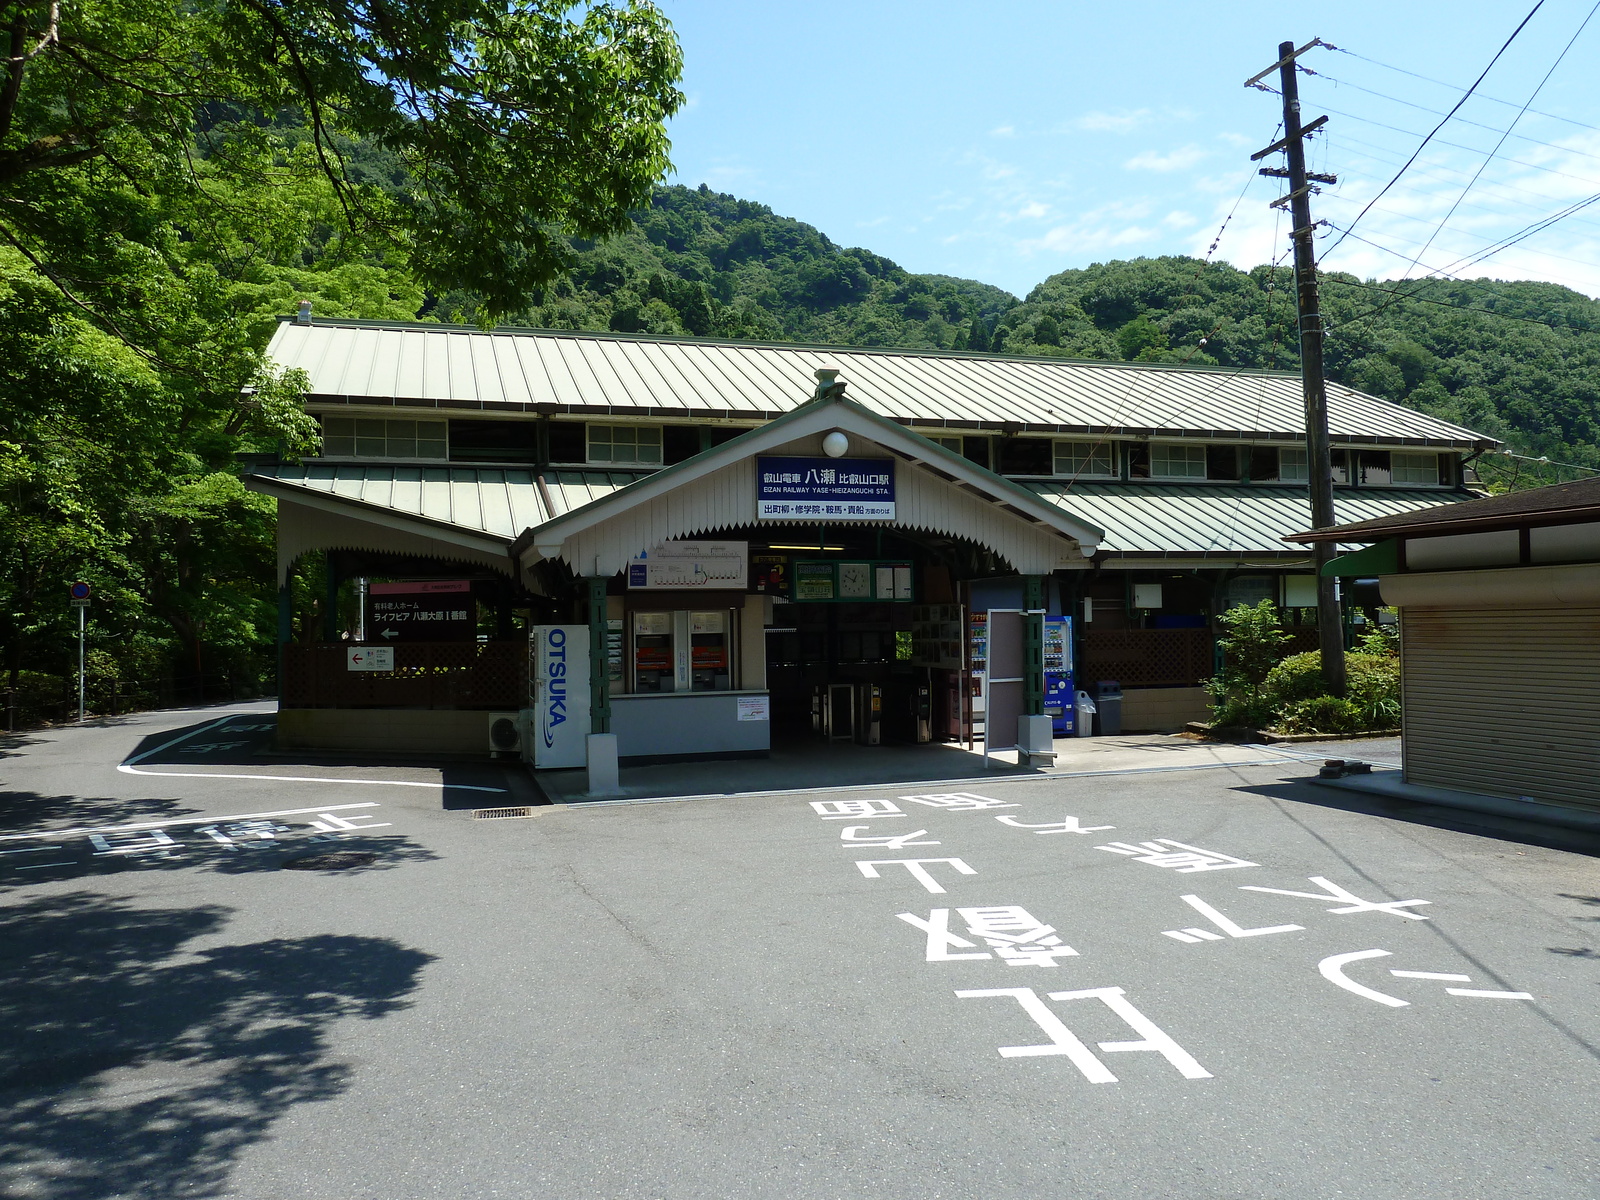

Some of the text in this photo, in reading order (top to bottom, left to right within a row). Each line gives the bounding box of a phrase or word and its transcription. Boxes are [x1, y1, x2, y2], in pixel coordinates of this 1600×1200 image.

[763, 468, 889, 485] 叡山電車 八瀬 比叡山口駅
[374, 602, 420, 611] 有料老人ホーム
[549, 629, 566, 727] OTSUKA
